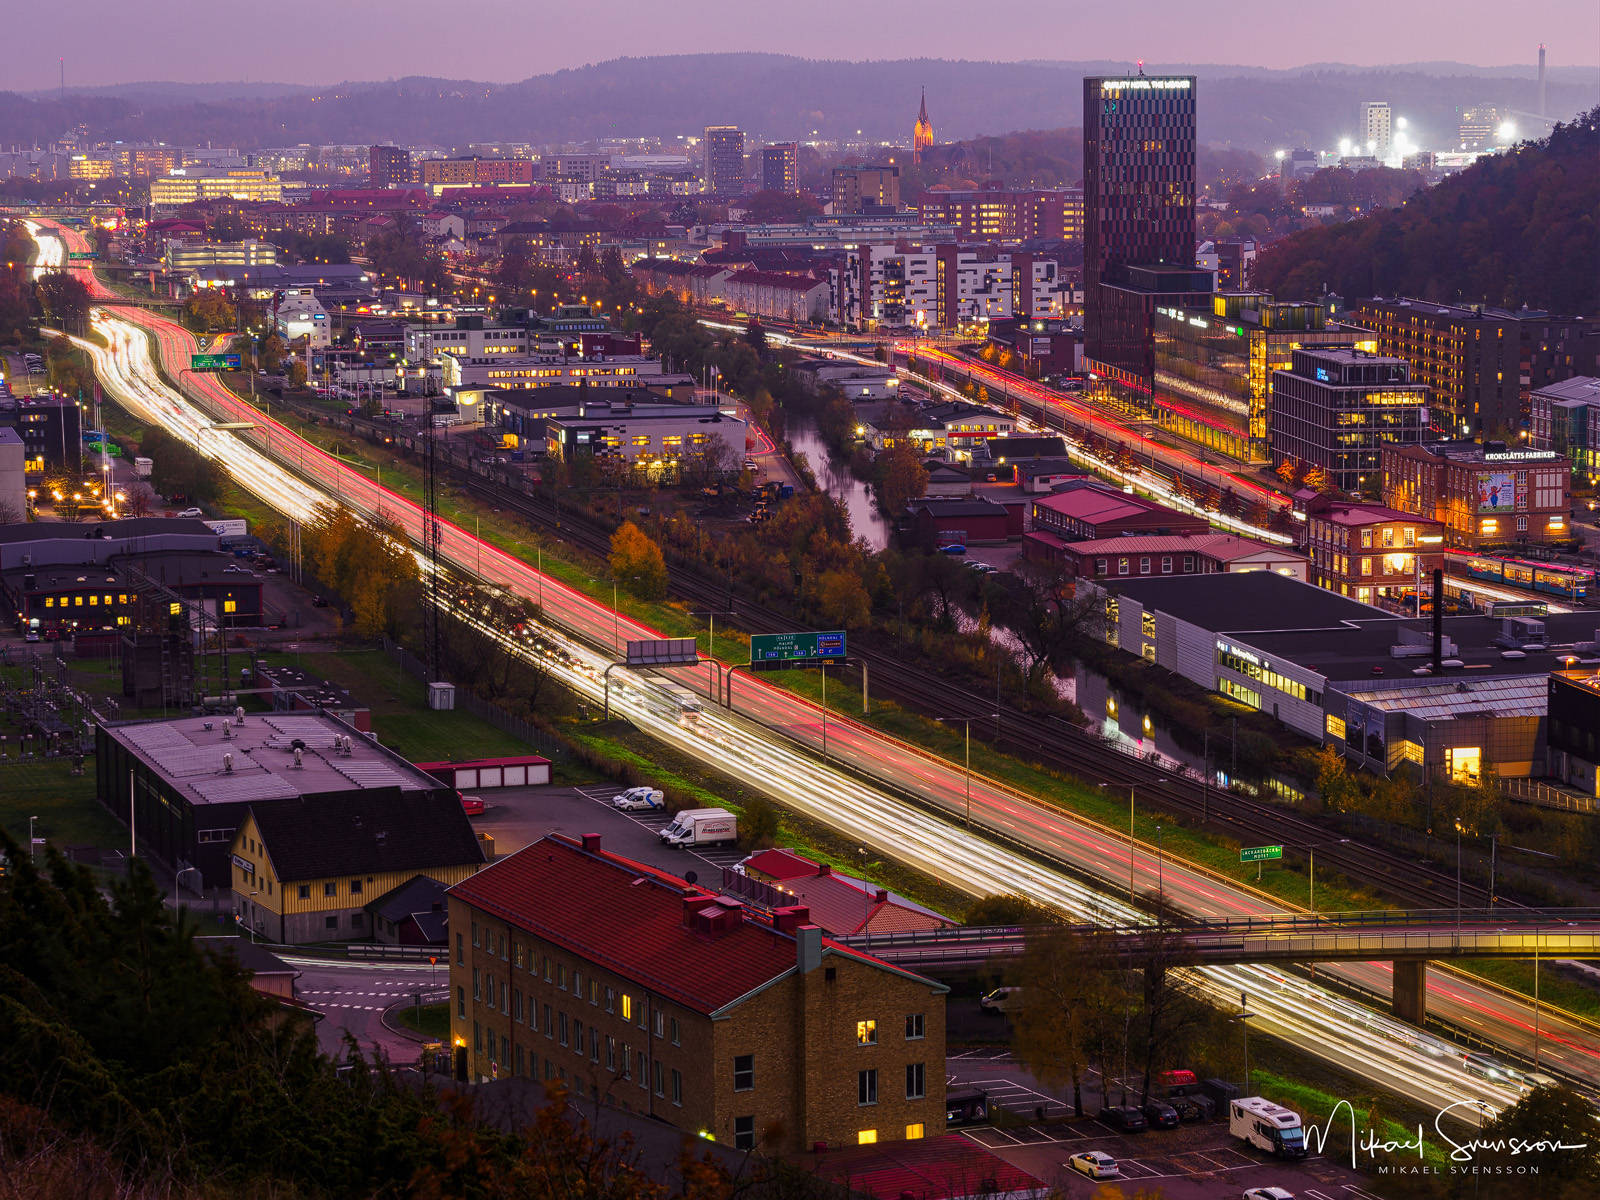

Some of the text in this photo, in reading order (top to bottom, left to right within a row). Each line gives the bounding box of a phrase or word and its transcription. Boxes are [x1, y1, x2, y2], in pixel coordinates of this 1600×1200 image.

[1151, 80, 1164, 89] THE
[1485, 451, 1556, 460] KROKSLÄTTS FABRIKER
